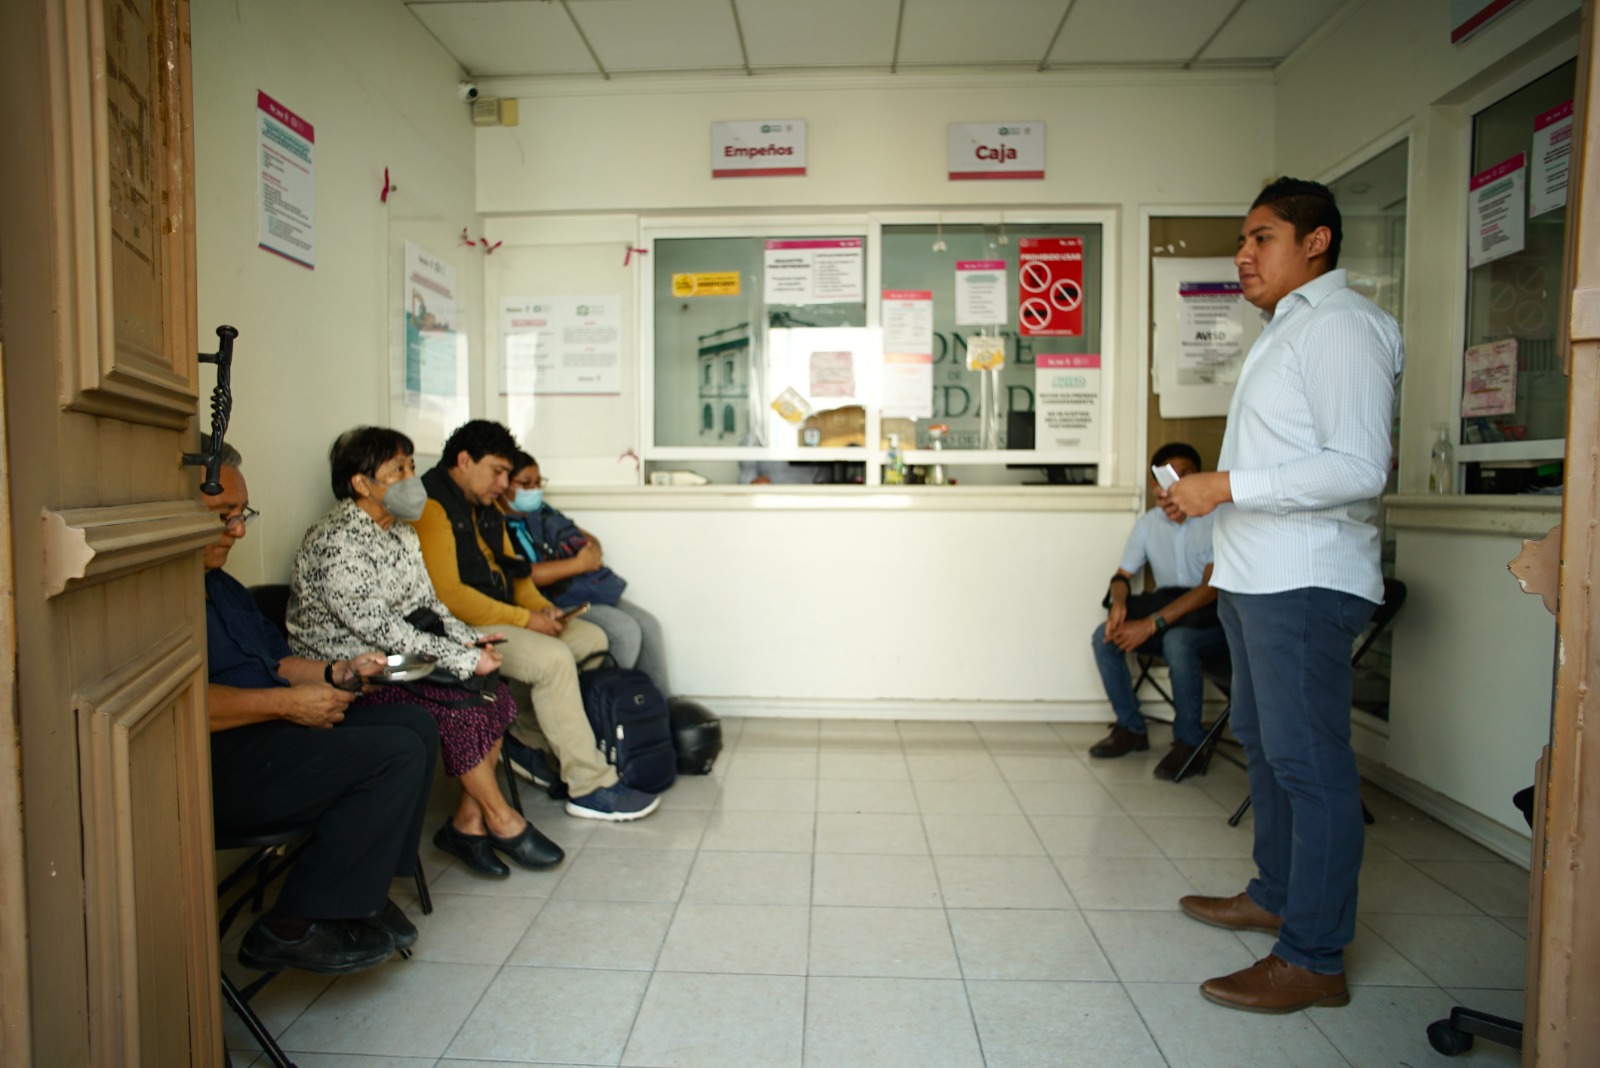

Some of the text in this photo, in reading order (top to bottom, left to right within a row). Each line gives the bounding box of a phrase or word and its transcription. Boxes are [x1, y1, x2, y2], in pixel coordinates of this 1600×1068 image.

[723, 144, 794, 159] Empeños
[975, 143, 1018, 164] Caja
[1194, 331, 1227, 341] AVISO
